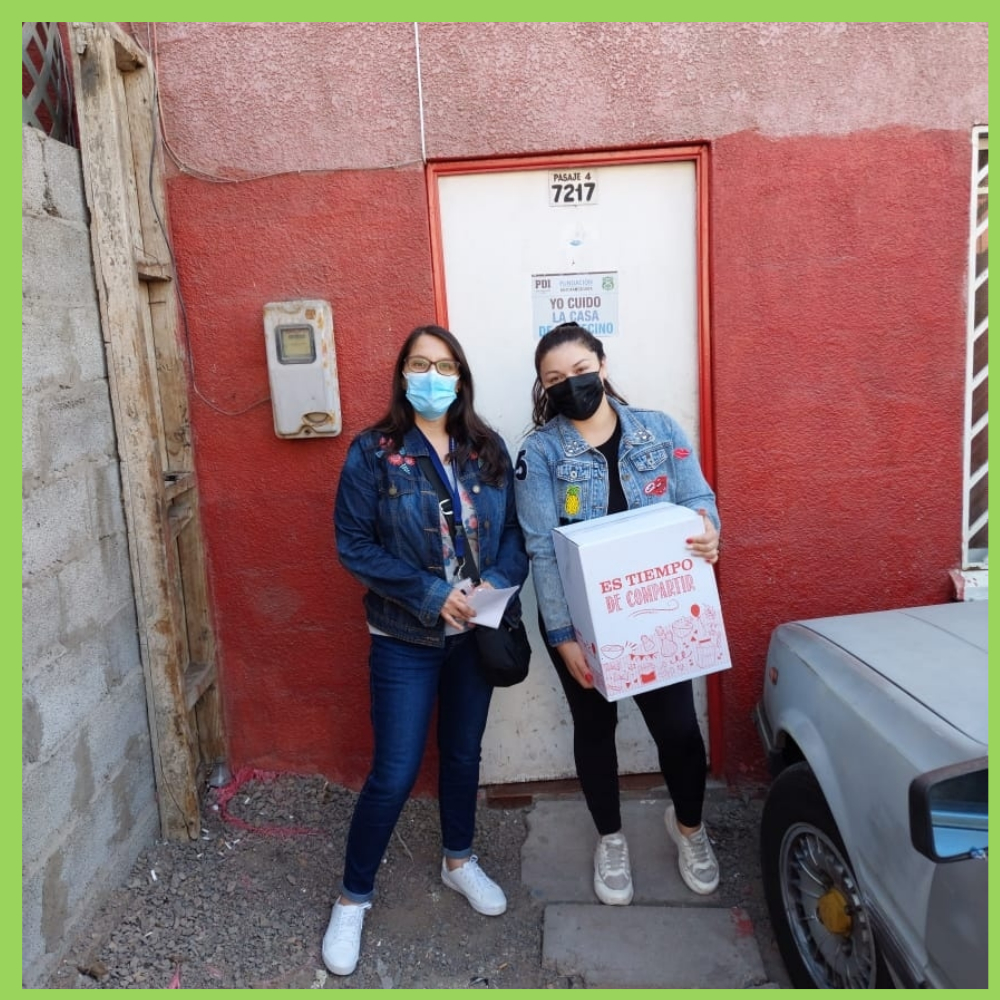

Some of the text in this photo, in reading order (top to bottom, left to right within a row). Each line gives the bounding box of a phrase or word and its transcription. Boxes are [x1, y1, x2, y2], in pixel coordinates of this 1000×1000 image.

[553, 172, 592, 182] PASAJE 4
[551, 182, 596, 203] 7217
[535, 279, 551, 289] PDI
[550, 296, 601, 310] YO CUIDO
[552, 310, 600, 323] LA CASA
[599, 558, 694, 594] ES TIEMPO
[604, 574, 696, 614] DE COMPARTIR
